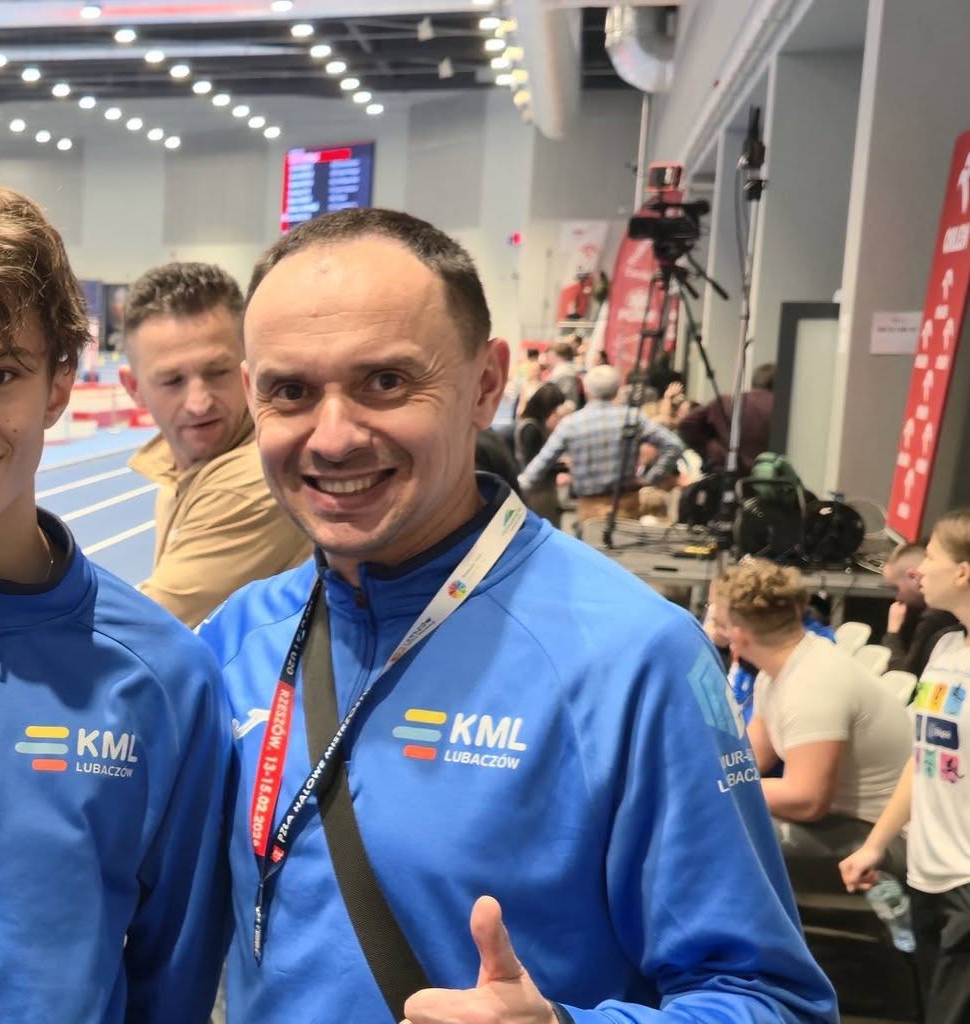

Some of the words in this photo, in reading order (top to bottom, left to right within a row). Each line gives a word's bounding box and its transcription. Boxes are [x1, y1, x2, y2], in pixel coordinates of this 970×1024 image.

[76, 728, 139, 763] KML
[449, 712, 528, 752] KML
[75, 761, 134, 778] LUBACZÓW
[444, 749, 521, 770] LUBACZÓW
[292, 759, 327, 814] HALOWE
